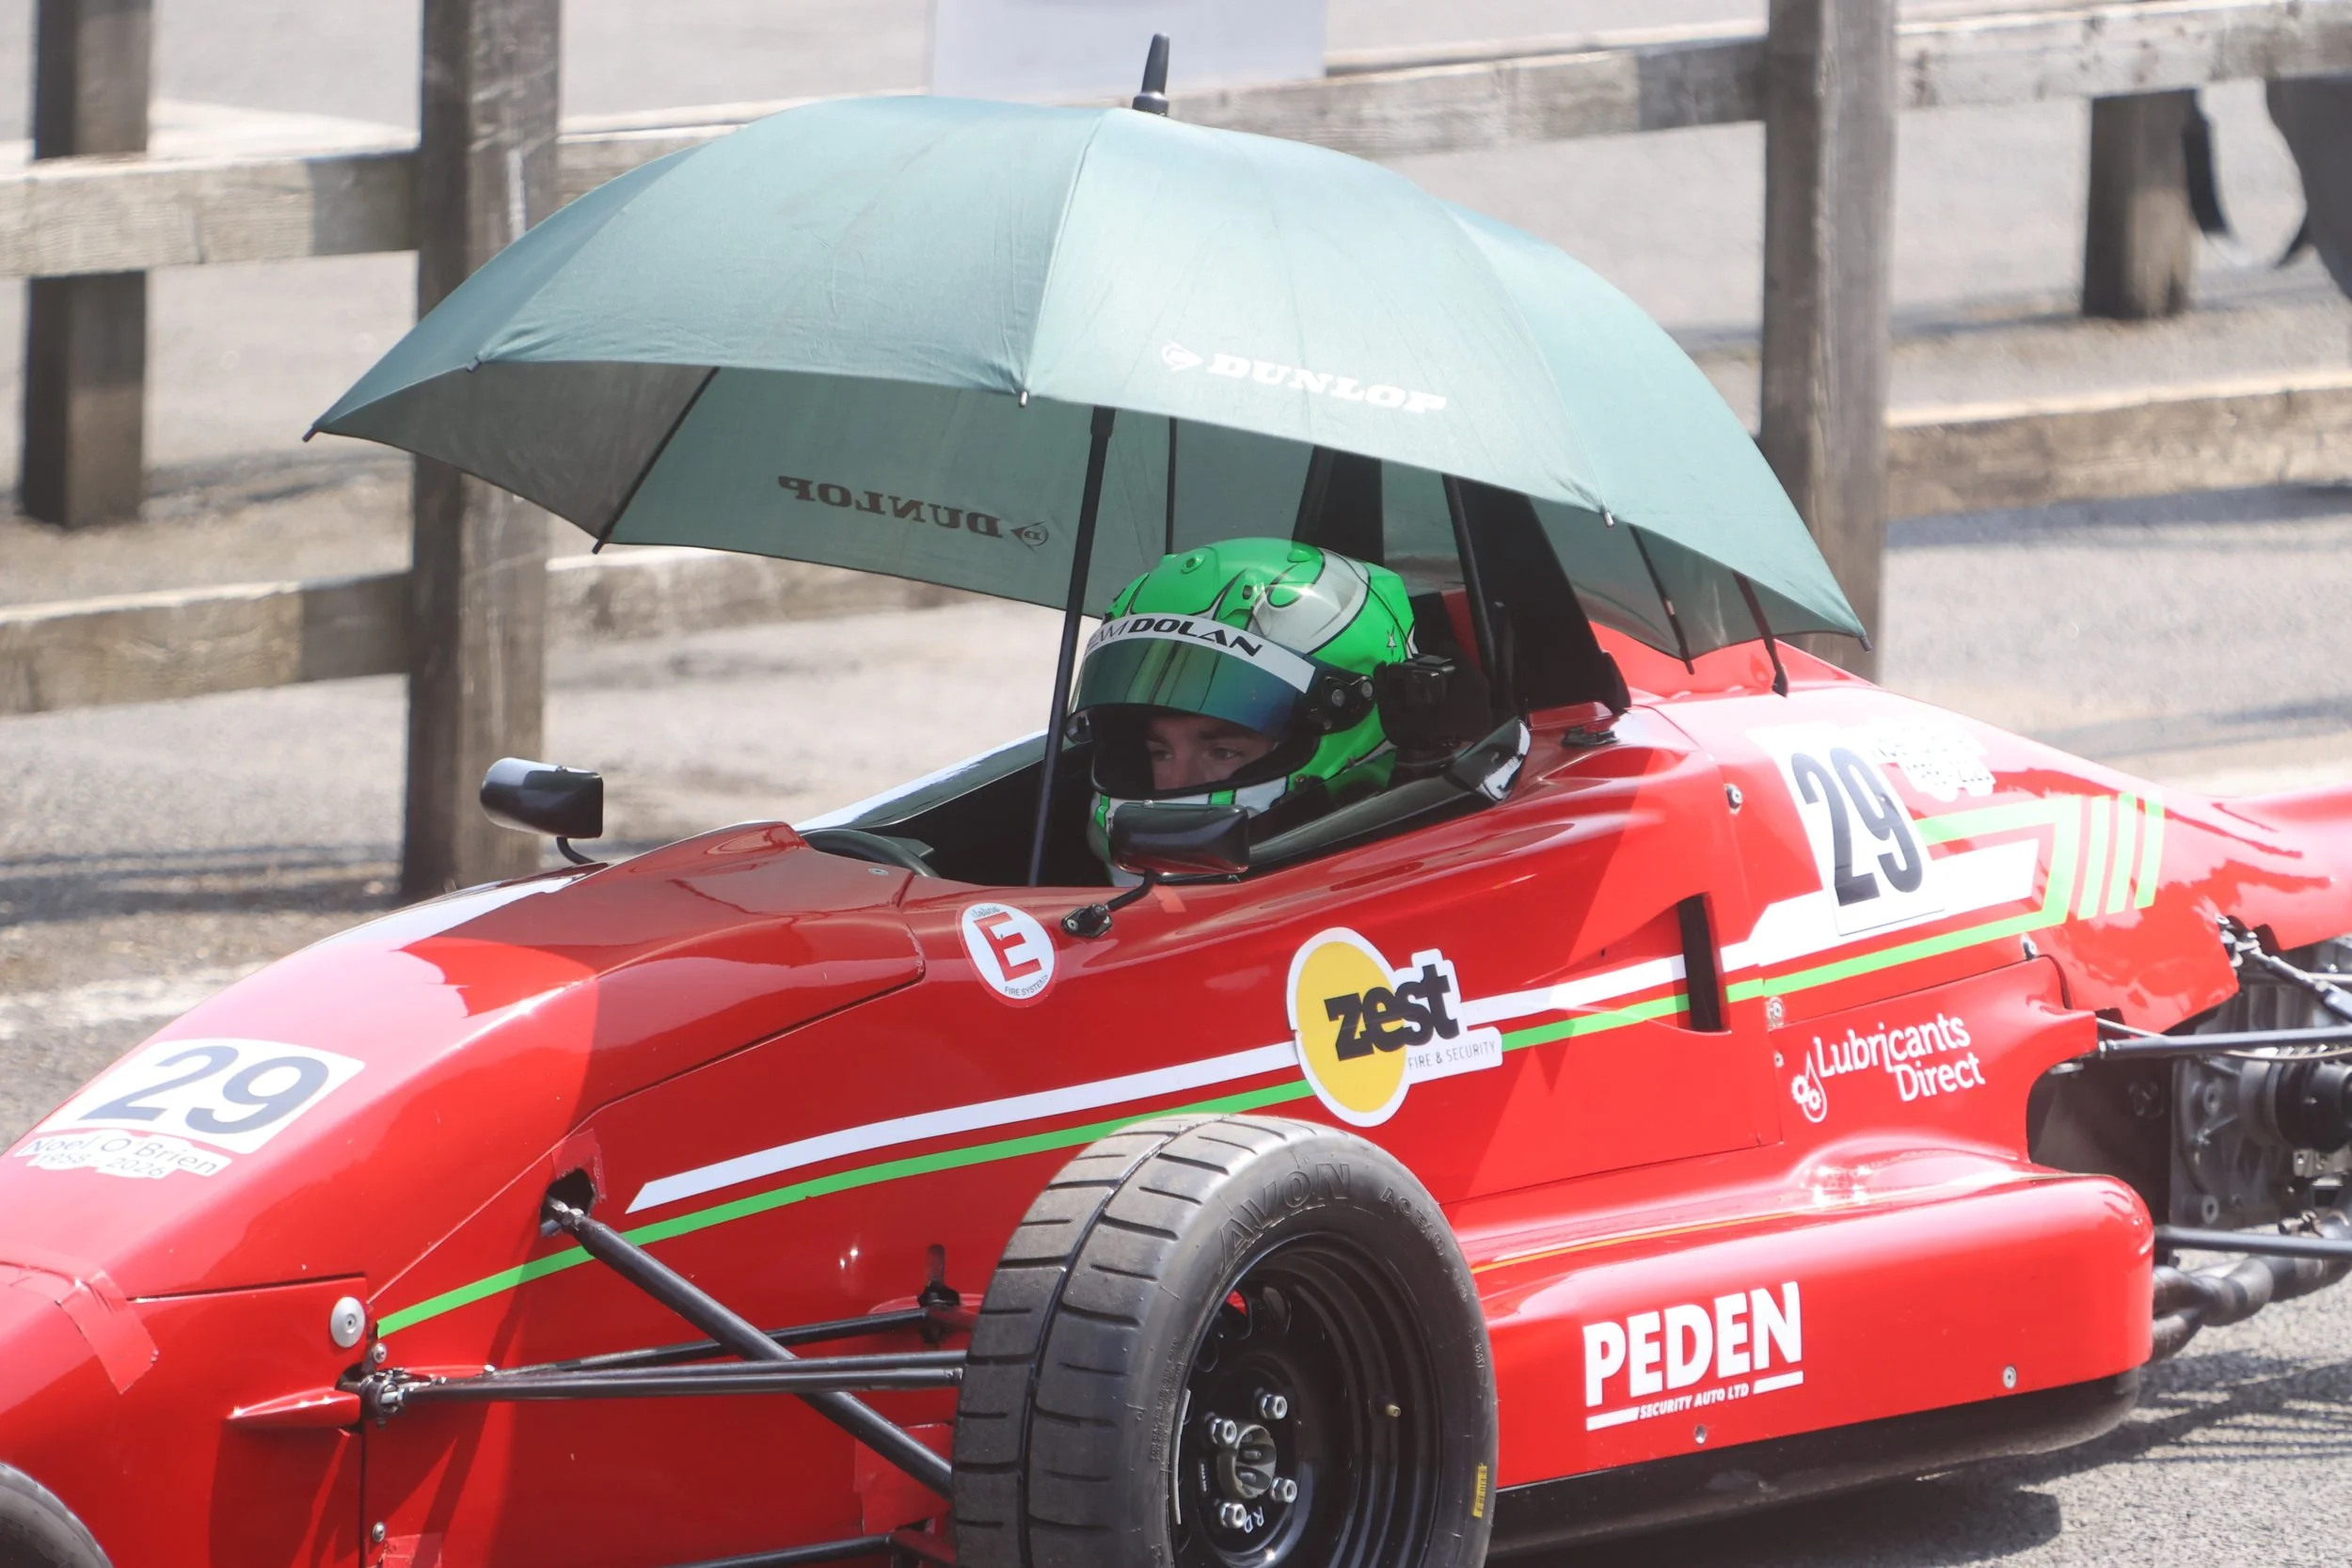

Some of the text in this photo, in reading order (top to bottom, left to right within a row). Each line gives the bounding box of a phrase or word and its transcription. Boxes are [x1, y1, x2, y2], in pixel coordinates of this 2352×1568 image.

[1206, 352, 1447, 414] DUNLOP
[1087, 618, 1263, 657] EAM DOLAN
[1791, 747, 1923, 907] 29
[972, 911, 1042, 982] E
[1004, 985, 1021, 996] FIRE
[1324, 964, 1461, 1061] zest
[1408, 1040, 1496, 1070] FIRE & SECURITY
[1813, 1011, 1971, 1078] Lubricants
[76, 1045, 330, 1134] 29
[1894, 1053, 1986, 1101] Direct
[22, 1134, 101, 1154] Noel
[105, 1157, 166, 1177] 2026
[1219, 1163, 1352, 1270] AVON
[1582, 1280, 1803, 1408] PEDEN
[1639, 1383, 1750, 1419] SECURITY AUTO LTD
